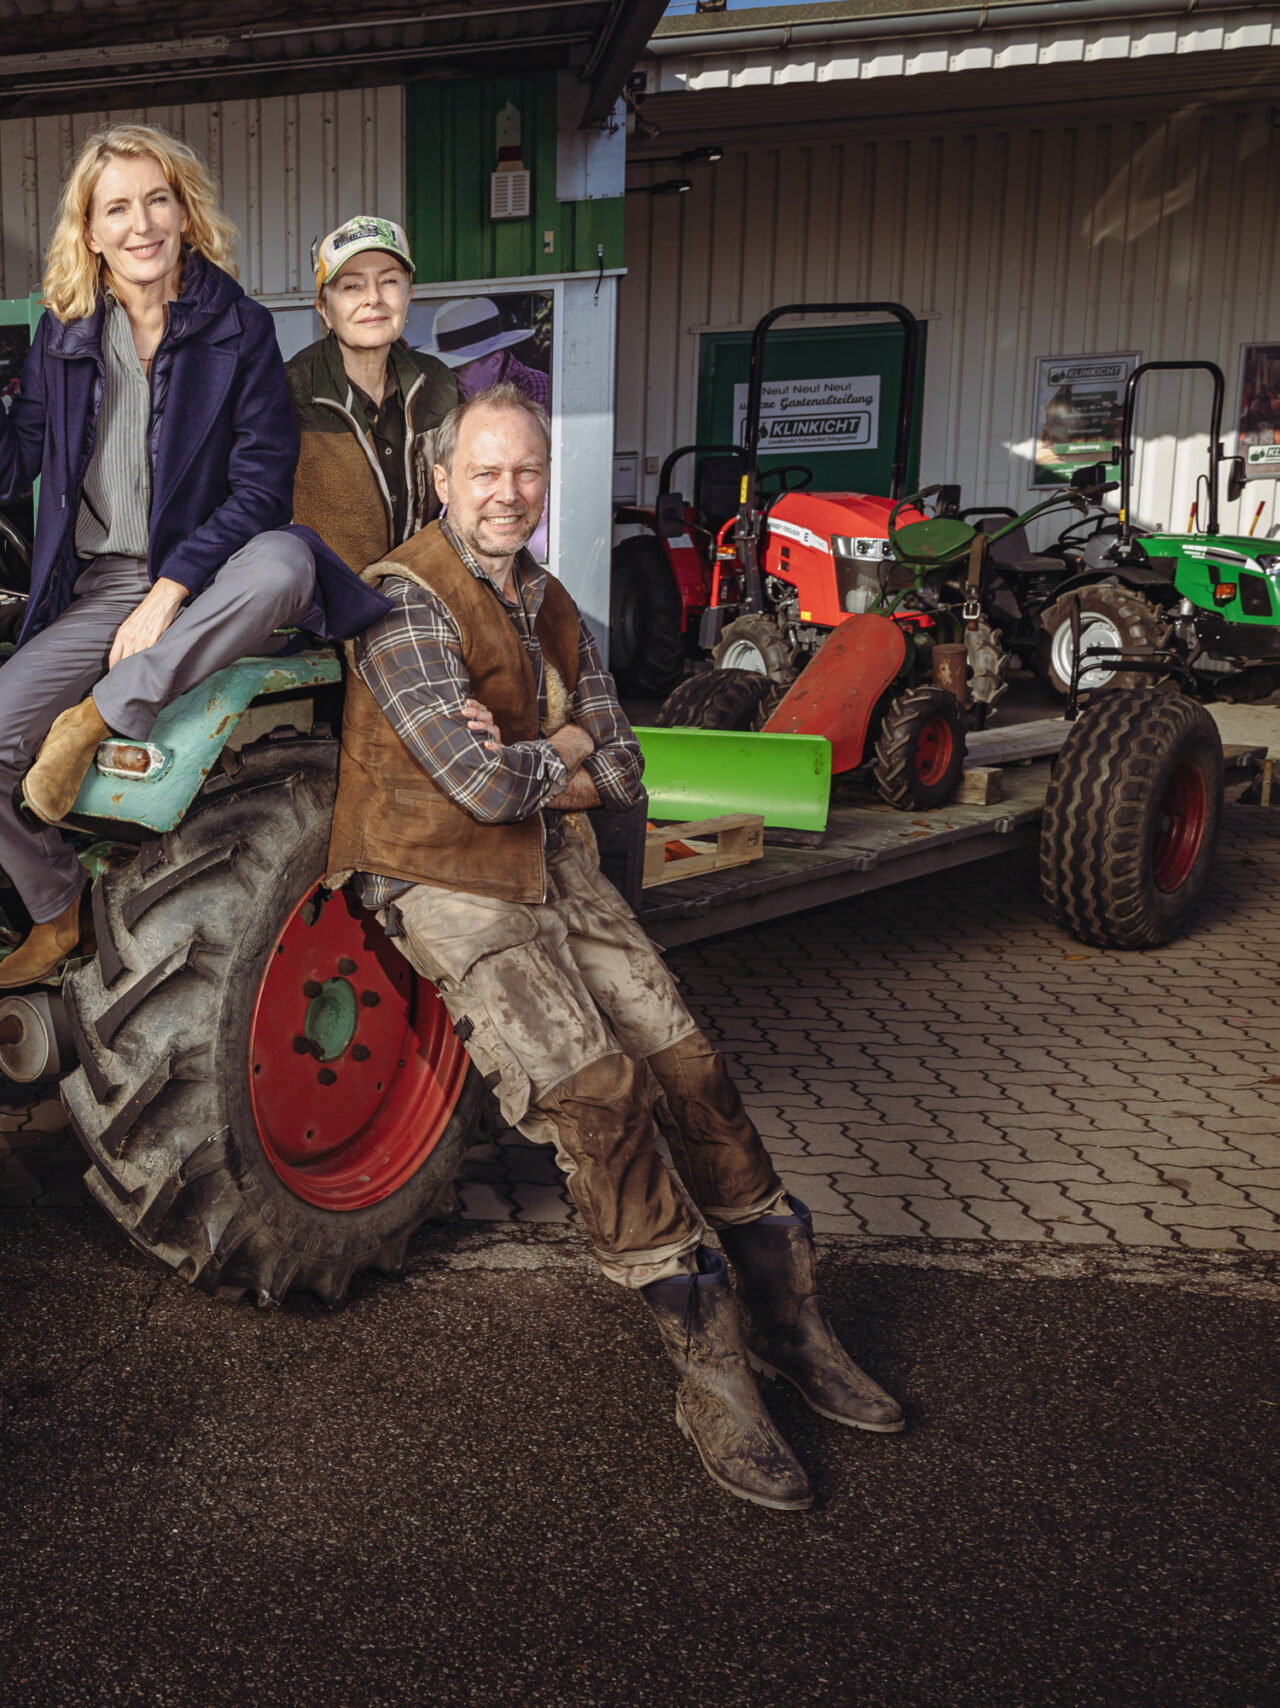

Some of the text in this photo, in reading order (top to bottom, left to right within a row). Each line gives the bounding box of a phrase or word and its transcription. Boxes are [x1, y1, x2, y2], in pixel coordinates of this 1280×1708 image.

[1067, 367, 1121, 378] KLINKICHT
[762, 382, 852, 396] Neu! Neu! Neu!
[780, 393, 874, 411] Gartenabteilung
[772, 418, 859, 436] KLINKICHT
